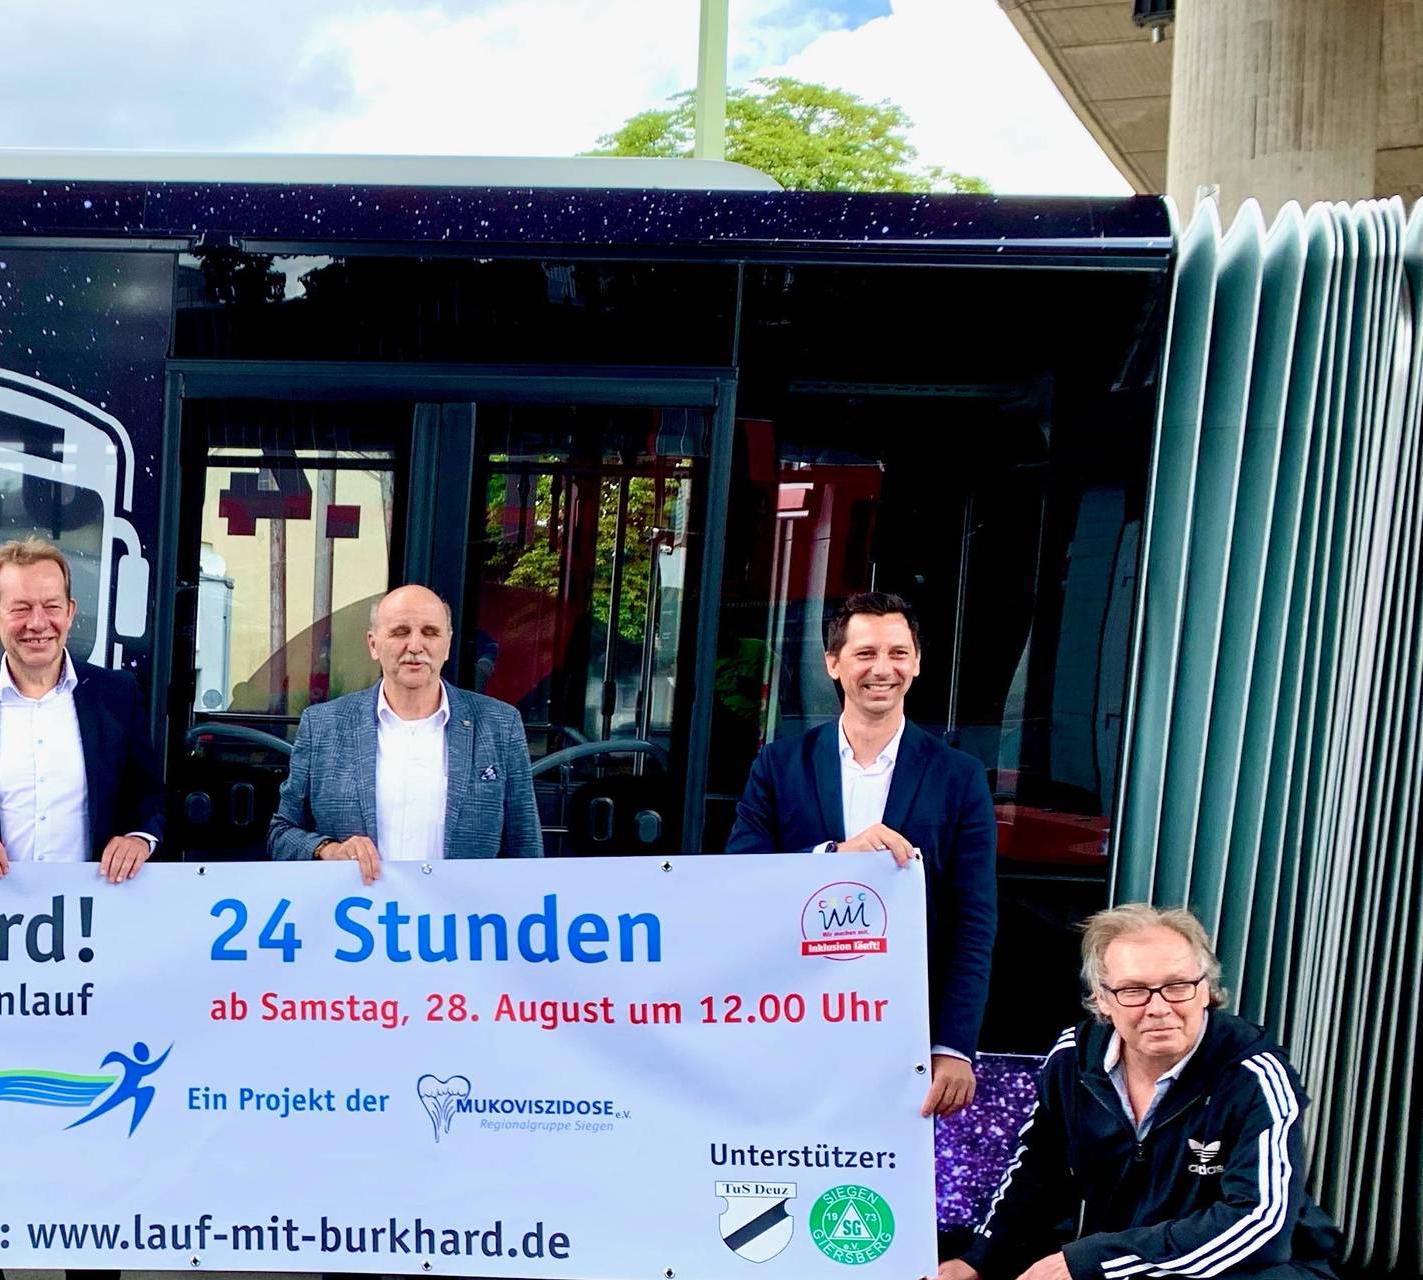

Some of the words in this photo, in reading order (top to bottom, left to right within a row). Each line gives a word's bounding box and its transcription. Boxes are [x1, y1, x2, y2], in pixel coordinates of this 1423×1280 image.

[209, 898, 303, 963] 24
[334, 892, 662, 964] Stunden
[808, 942, 852, 953] Inklusion
[210, 993, 250, 1022] ab
[261, 992, 411, 1029] Samstag,
[425, 995, 480, 1023] 28.
[494, 993, 615, 1030] August
[628, 1002, 682, 1025] um
[700, 995, 806, 1024] 12.00
[822, 992, 889, 1023] Uhr
[188, 1087, 231, 1112] Ein
[238, 1087, 336, 1118] Projekt
[345, 1087, 390, 1113] der
[456, 1099, 614, 1116] MUKOVISZIDOSE
[615, 1110, 632, 1120] e.V.
[480, 1119, 571, 1132] Regionalgruppe
[574, 1120, 614, 1133] Siegen
[710, 1143, 896, 1169] Unterstützer:
[722, 1183, 751, 1195] TuS
[755, 1184, 789, 1196] Deuz
[823, 1186, 879, 1205] SIEGEN
[825, 1212, 838, 1222] 19
[864, 1212, 878, 1222] 73
[842, 1219, 862, 1236] SG
[27, 1214, 571, 1260] www.lauf-mit-burkhard.de
[812, 1229, 893, 1264] GIERSBERG
